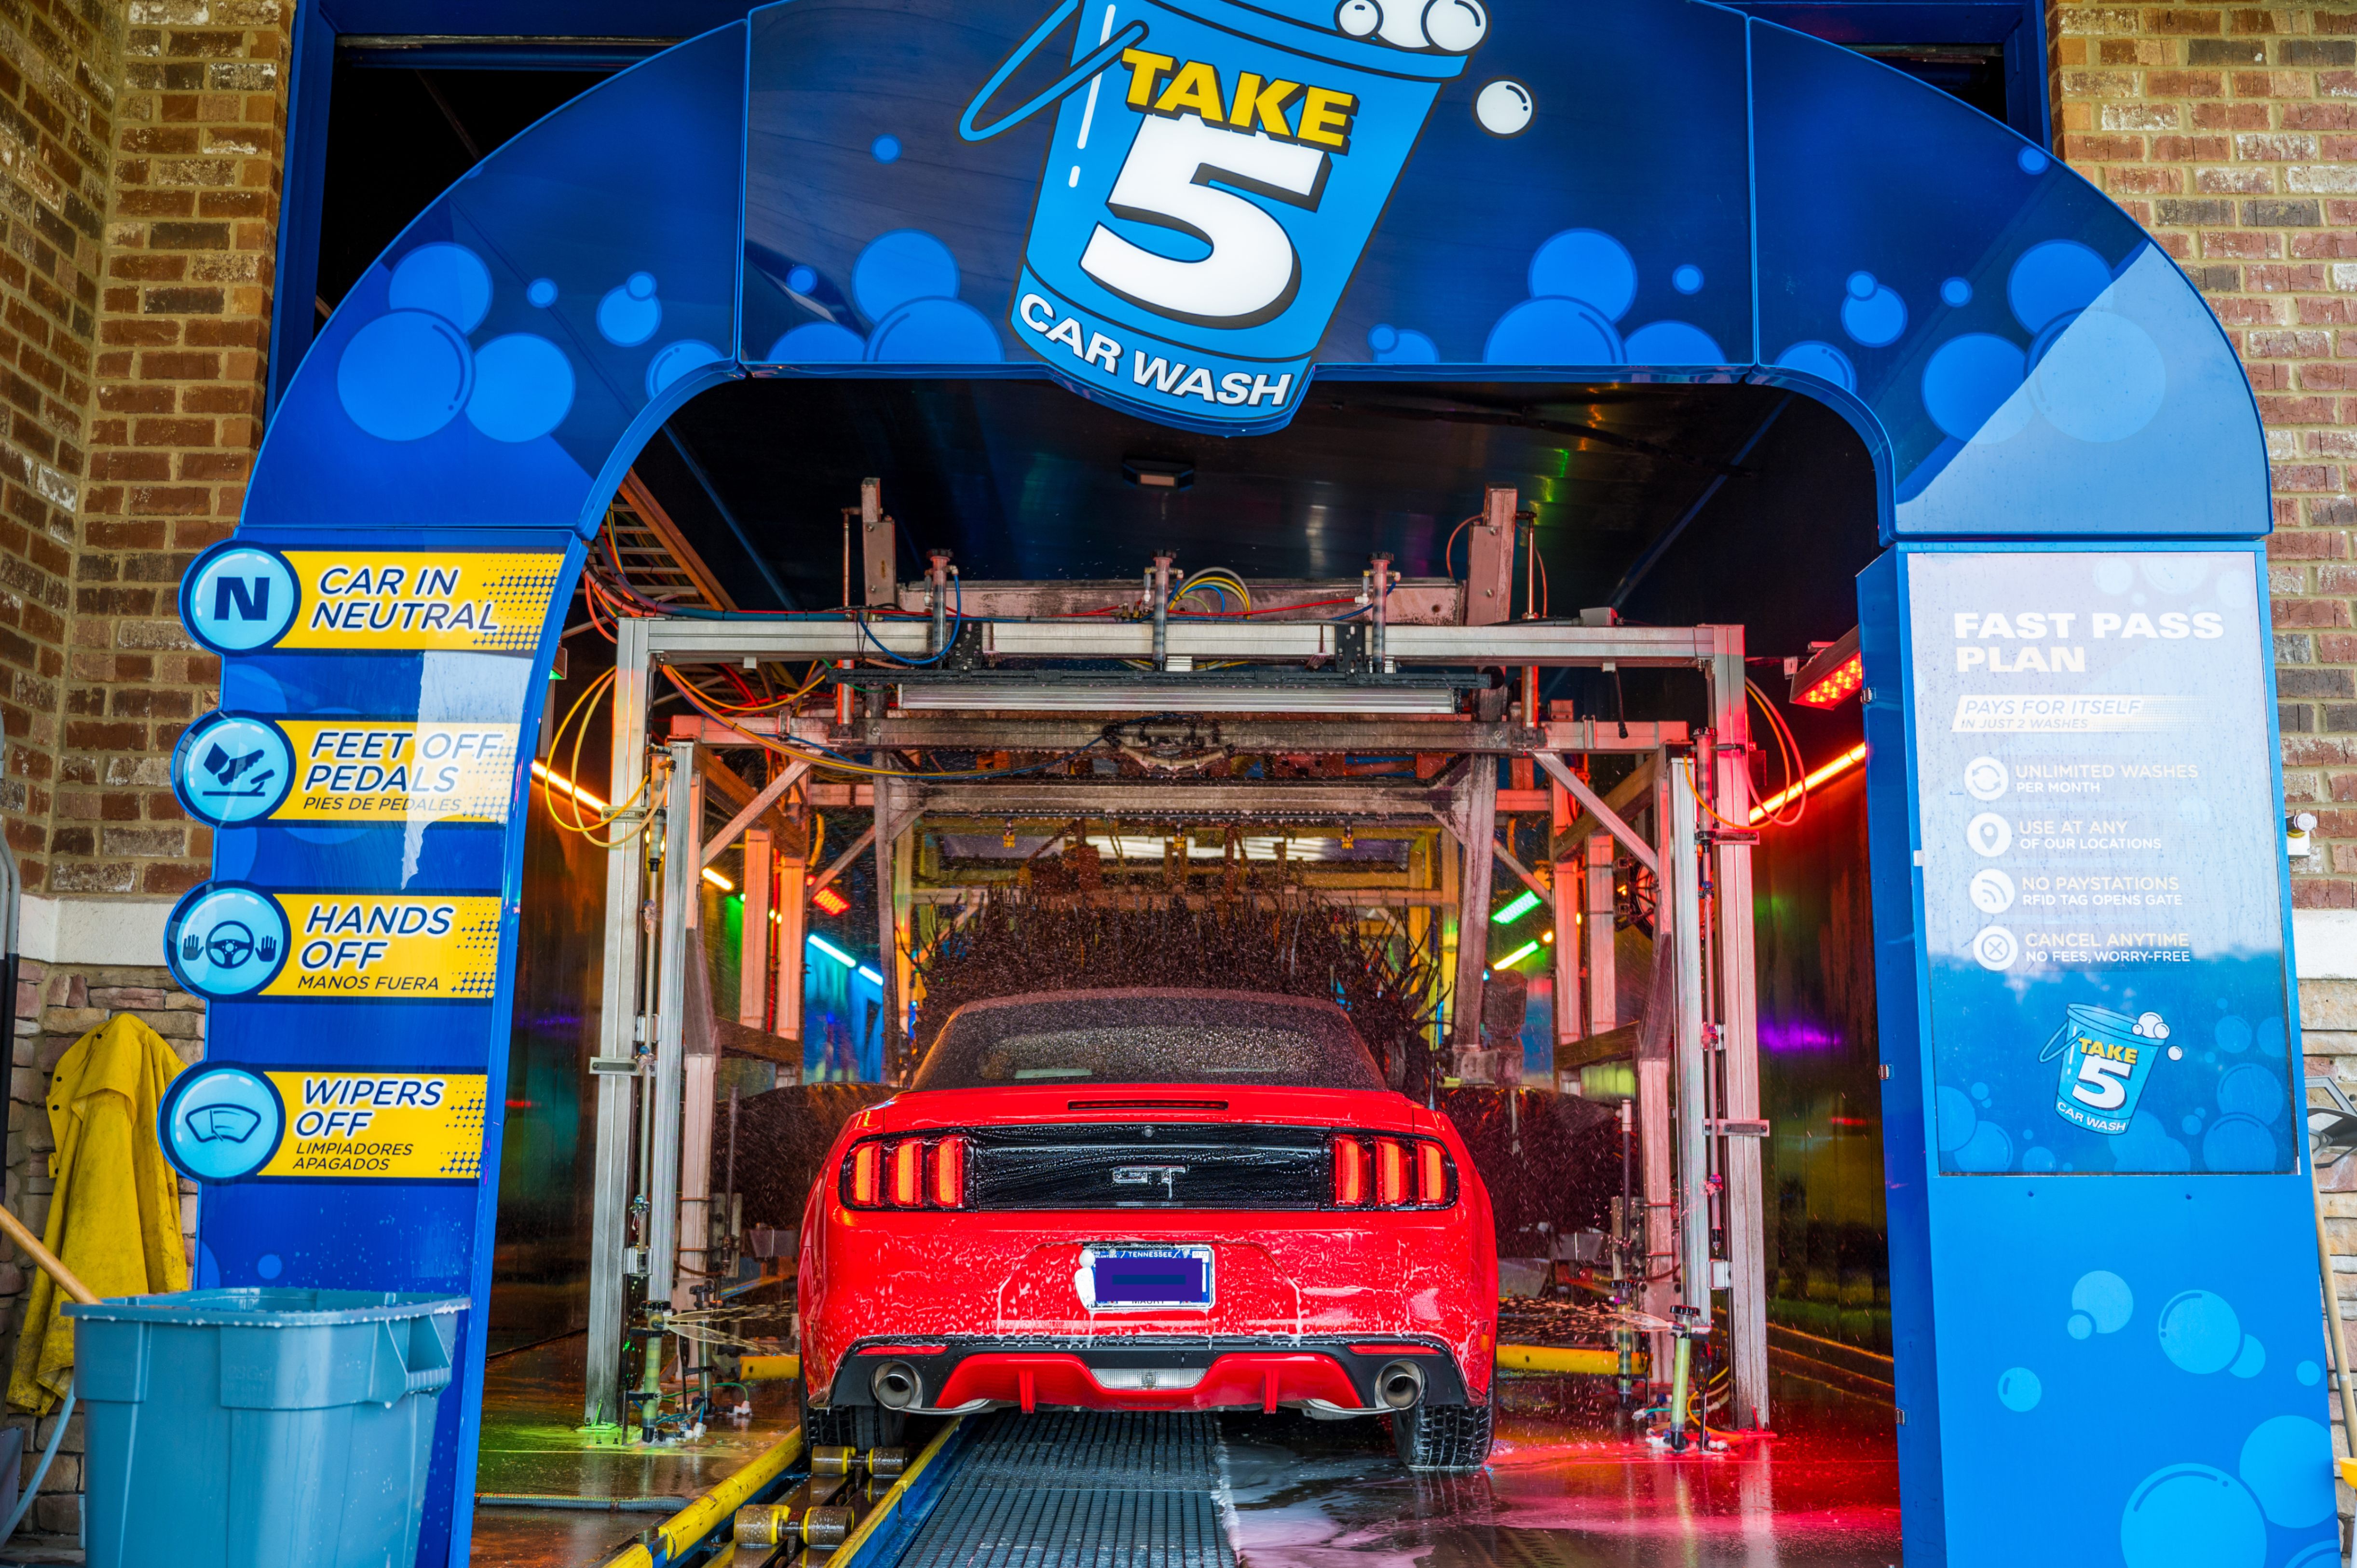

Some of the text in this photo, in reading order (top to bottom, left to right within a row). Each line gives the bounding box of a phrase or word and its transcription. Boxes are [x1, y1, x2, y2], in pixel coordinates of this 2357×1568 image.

[1122, 47, 1359, 155] TAKE
[1079, 114, 1333, 327] 5
[1019, 292, 1294, 409] CAR WASH
[321, 568, 459, 596] CAR IN
[214, 576, 270, 621] N
[312, 602, 499, 630] NEUTRAL
[1954, 612, 2224, 640] FAST PASS
[1956, 646, 2085, 672] PLAN
[1965, 700, 2141, 715] PAYS FOR ITSELF
[1961, 718, 2088, 729] IN JUST 2 WASHES
[312, 732, 503, 760] FEET OFF
[304, 765, 459, 792] PEDALS
[2016, 764, 2199, 778] UNLIMITED WASHES
[2016, 782, 2100, 793] PER MONTH
[303, 797, 462, 812] PIES DE PEDALES
[2019, 821, 2128, 834] USE AT ANY
[2019, 838, 2162, 849] OF OUR LOCATIONS
[2022, 877, 2180, 891] NO PAYSTATIONS
[2023, 895, 2183, 906] RFID TAG OPENS GATE
[307, 905, 454, 934] HANDS
[2025, 933, 2189, 947] CANCEL ANYTIME
[300, 941, 387, 969] OFF
[2026, 951, 2190, 964] NO FEES, WORRY-FREE
[298, 975, 439, 991] MANOS FUERA
[2078, 1037, 2139, 1065] TAKE
[305, 1079, 444, 1106] WIPERS
[2072, 1055, 2132, 1111] 5
[296, 1112, 372, 1137] OFF
[2057, 1102, 2126, 1131] CAR WASH
[296, 1143, 413, 1156] LIMPIADORES
[292, 1157, 390, 1171] APAGADOS
